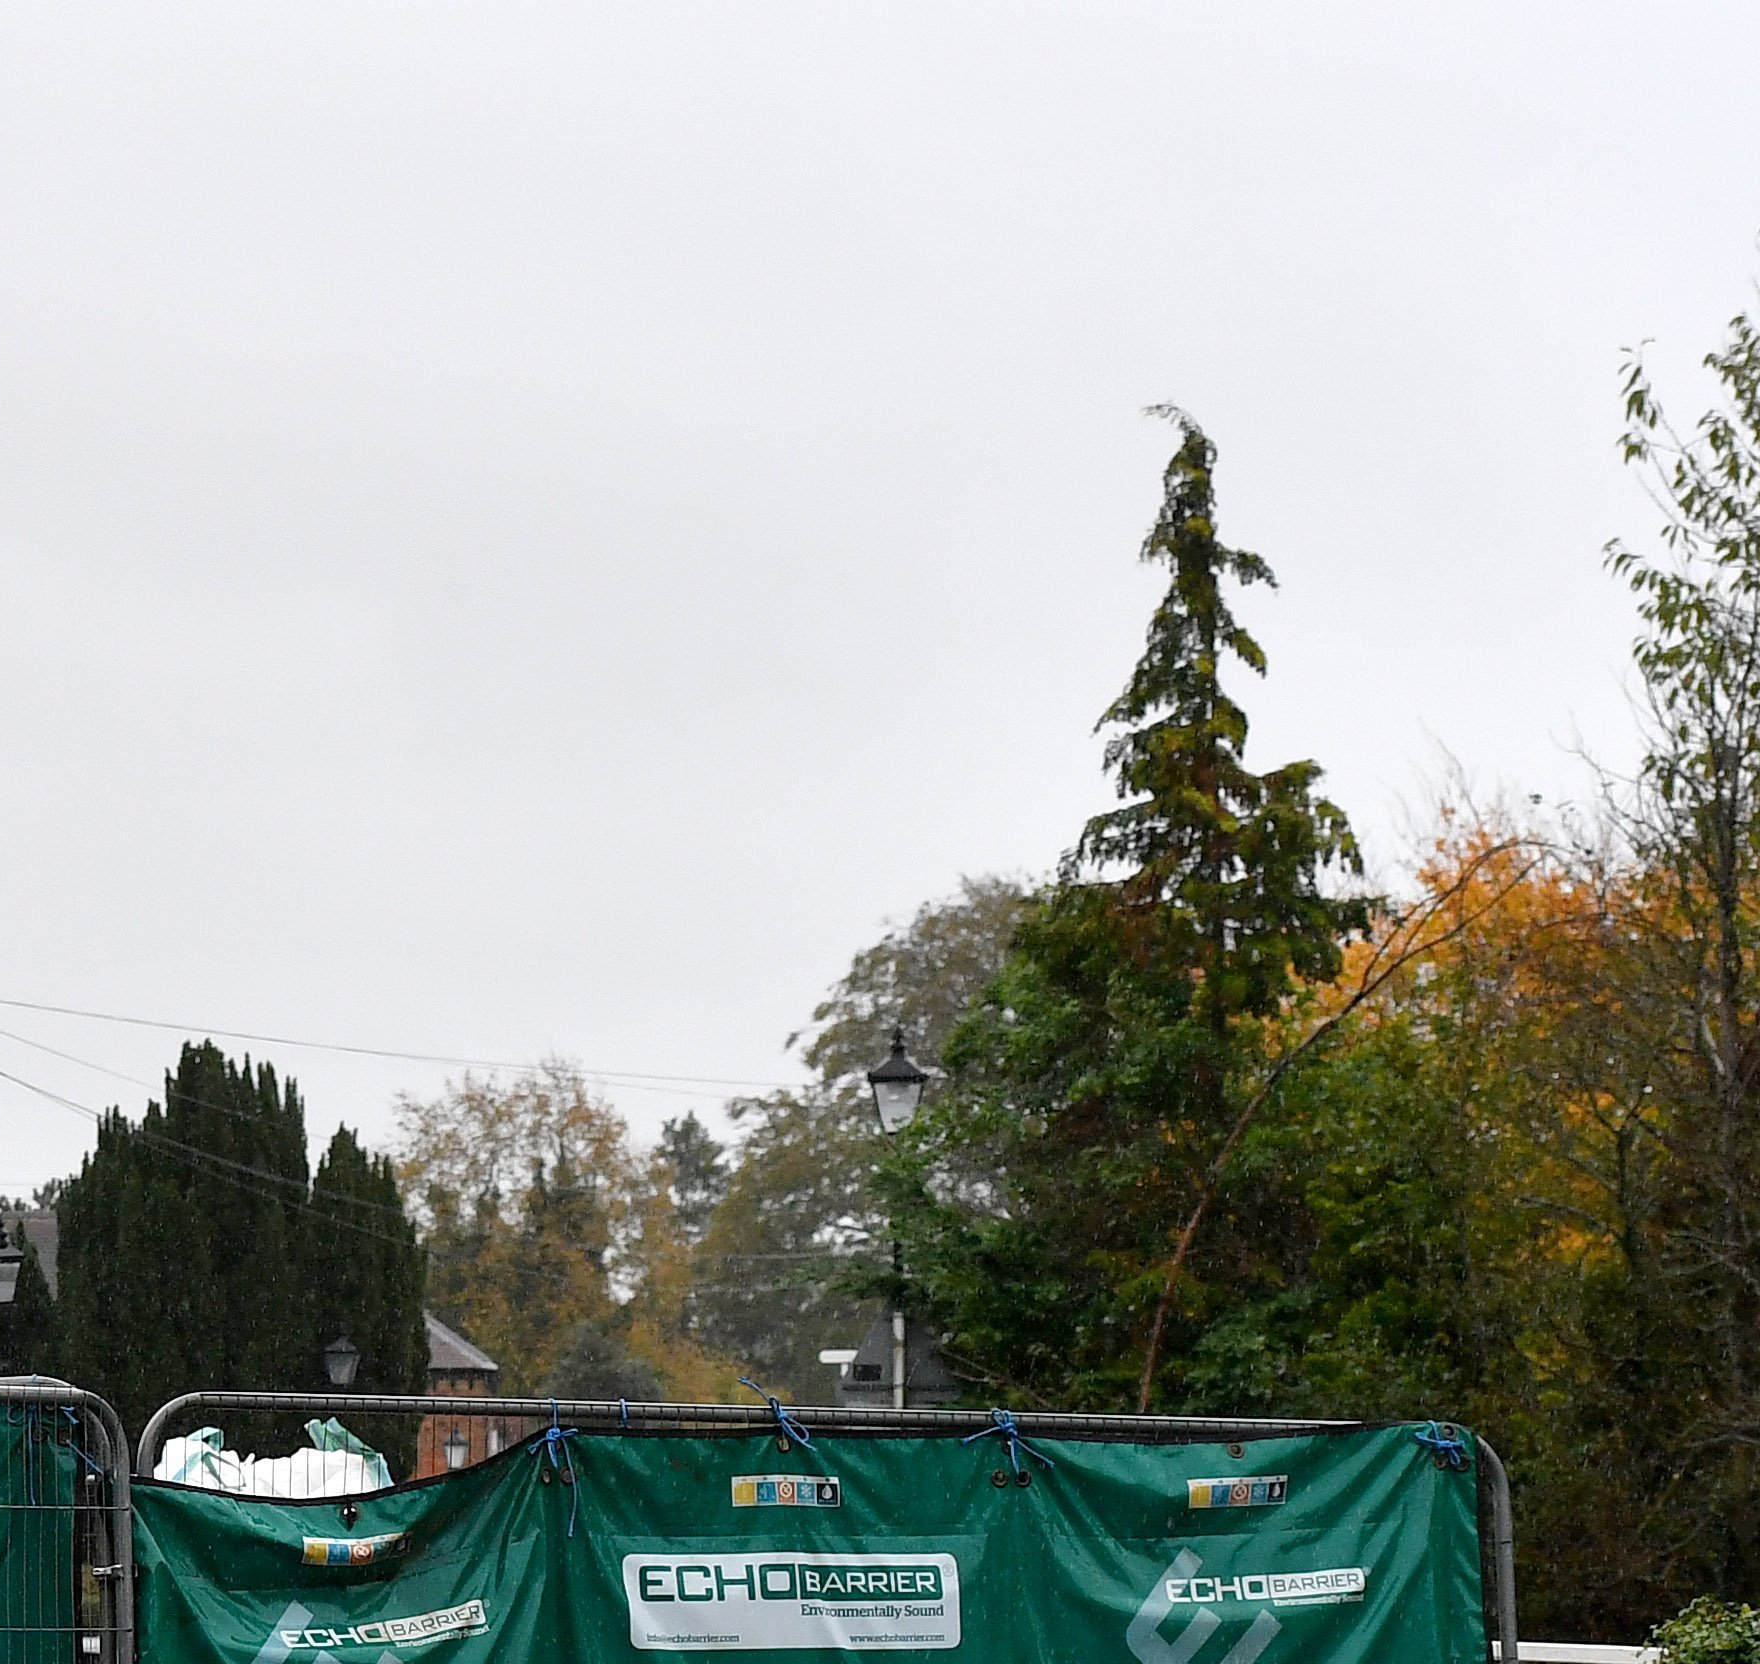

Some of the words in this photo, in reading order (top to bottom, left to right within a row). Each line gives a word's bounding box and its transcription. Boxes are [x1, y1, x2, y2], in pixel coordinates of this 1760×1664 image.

[639, 1563, 799, 1601] ECHO
[805, 1571, 938, 1594] BARRIER
[1166, 1575, 1269, 1603] ECHO
[1273, 1572, 1361, 1593] BARRIER
[280, 1622, 390, 1648] ECHO
[390, 1604, 481, 1637] BARRIER
[801, 1604, 903, 1619] Environmentally
[904, 1604, 945, 1617] Sound
[849, 1633, 946, 1643] www.echobarrier.com
